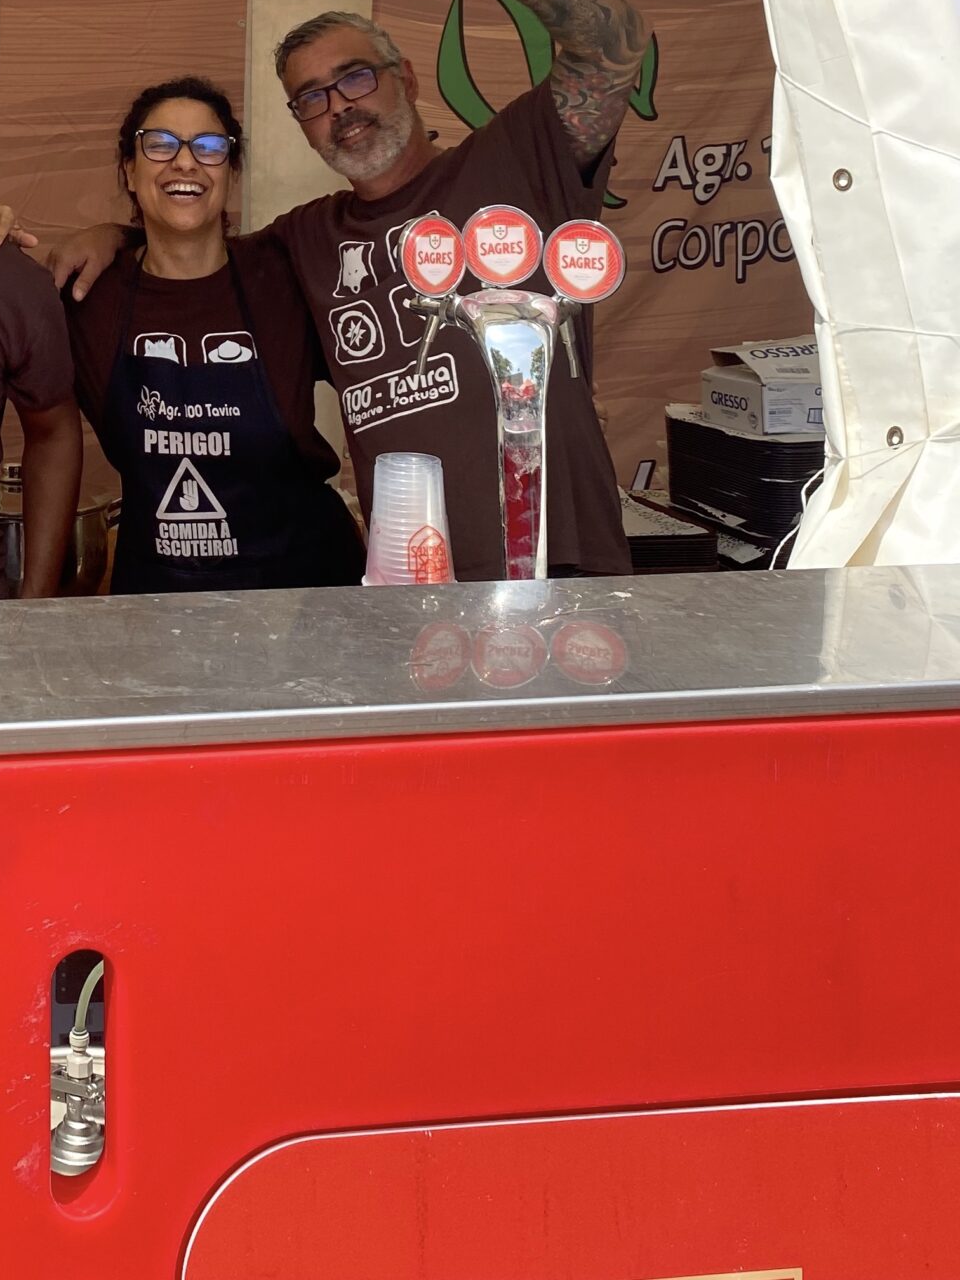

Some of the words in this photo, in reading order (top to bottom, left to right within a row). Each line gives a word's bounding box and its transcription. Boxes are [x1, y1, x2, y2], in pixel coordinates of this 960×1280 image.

[652, 135, 752, 205] Agr.
[417, 251, 453, 266] SAGRES
[480, 241, 524, 256] SAGRES
[561, 255, 605, 271] SAGRES
[346, 386, 372, 414] 100
[387, 366, 450, 399] Tavira
[393, 380, 454, 408] Portugal
[158, 400, 181, 420] Agr.
[205, 403, 240, 417] Tavira
[711, 391, 748, 411] GRESSO
[144, 429, 231, 456] PERIGO!
[159, 522, 218, 539] COMIDA
[220, 519, 232, 539] À
[156, 537, 239, 557] ESCUTEIRO!
